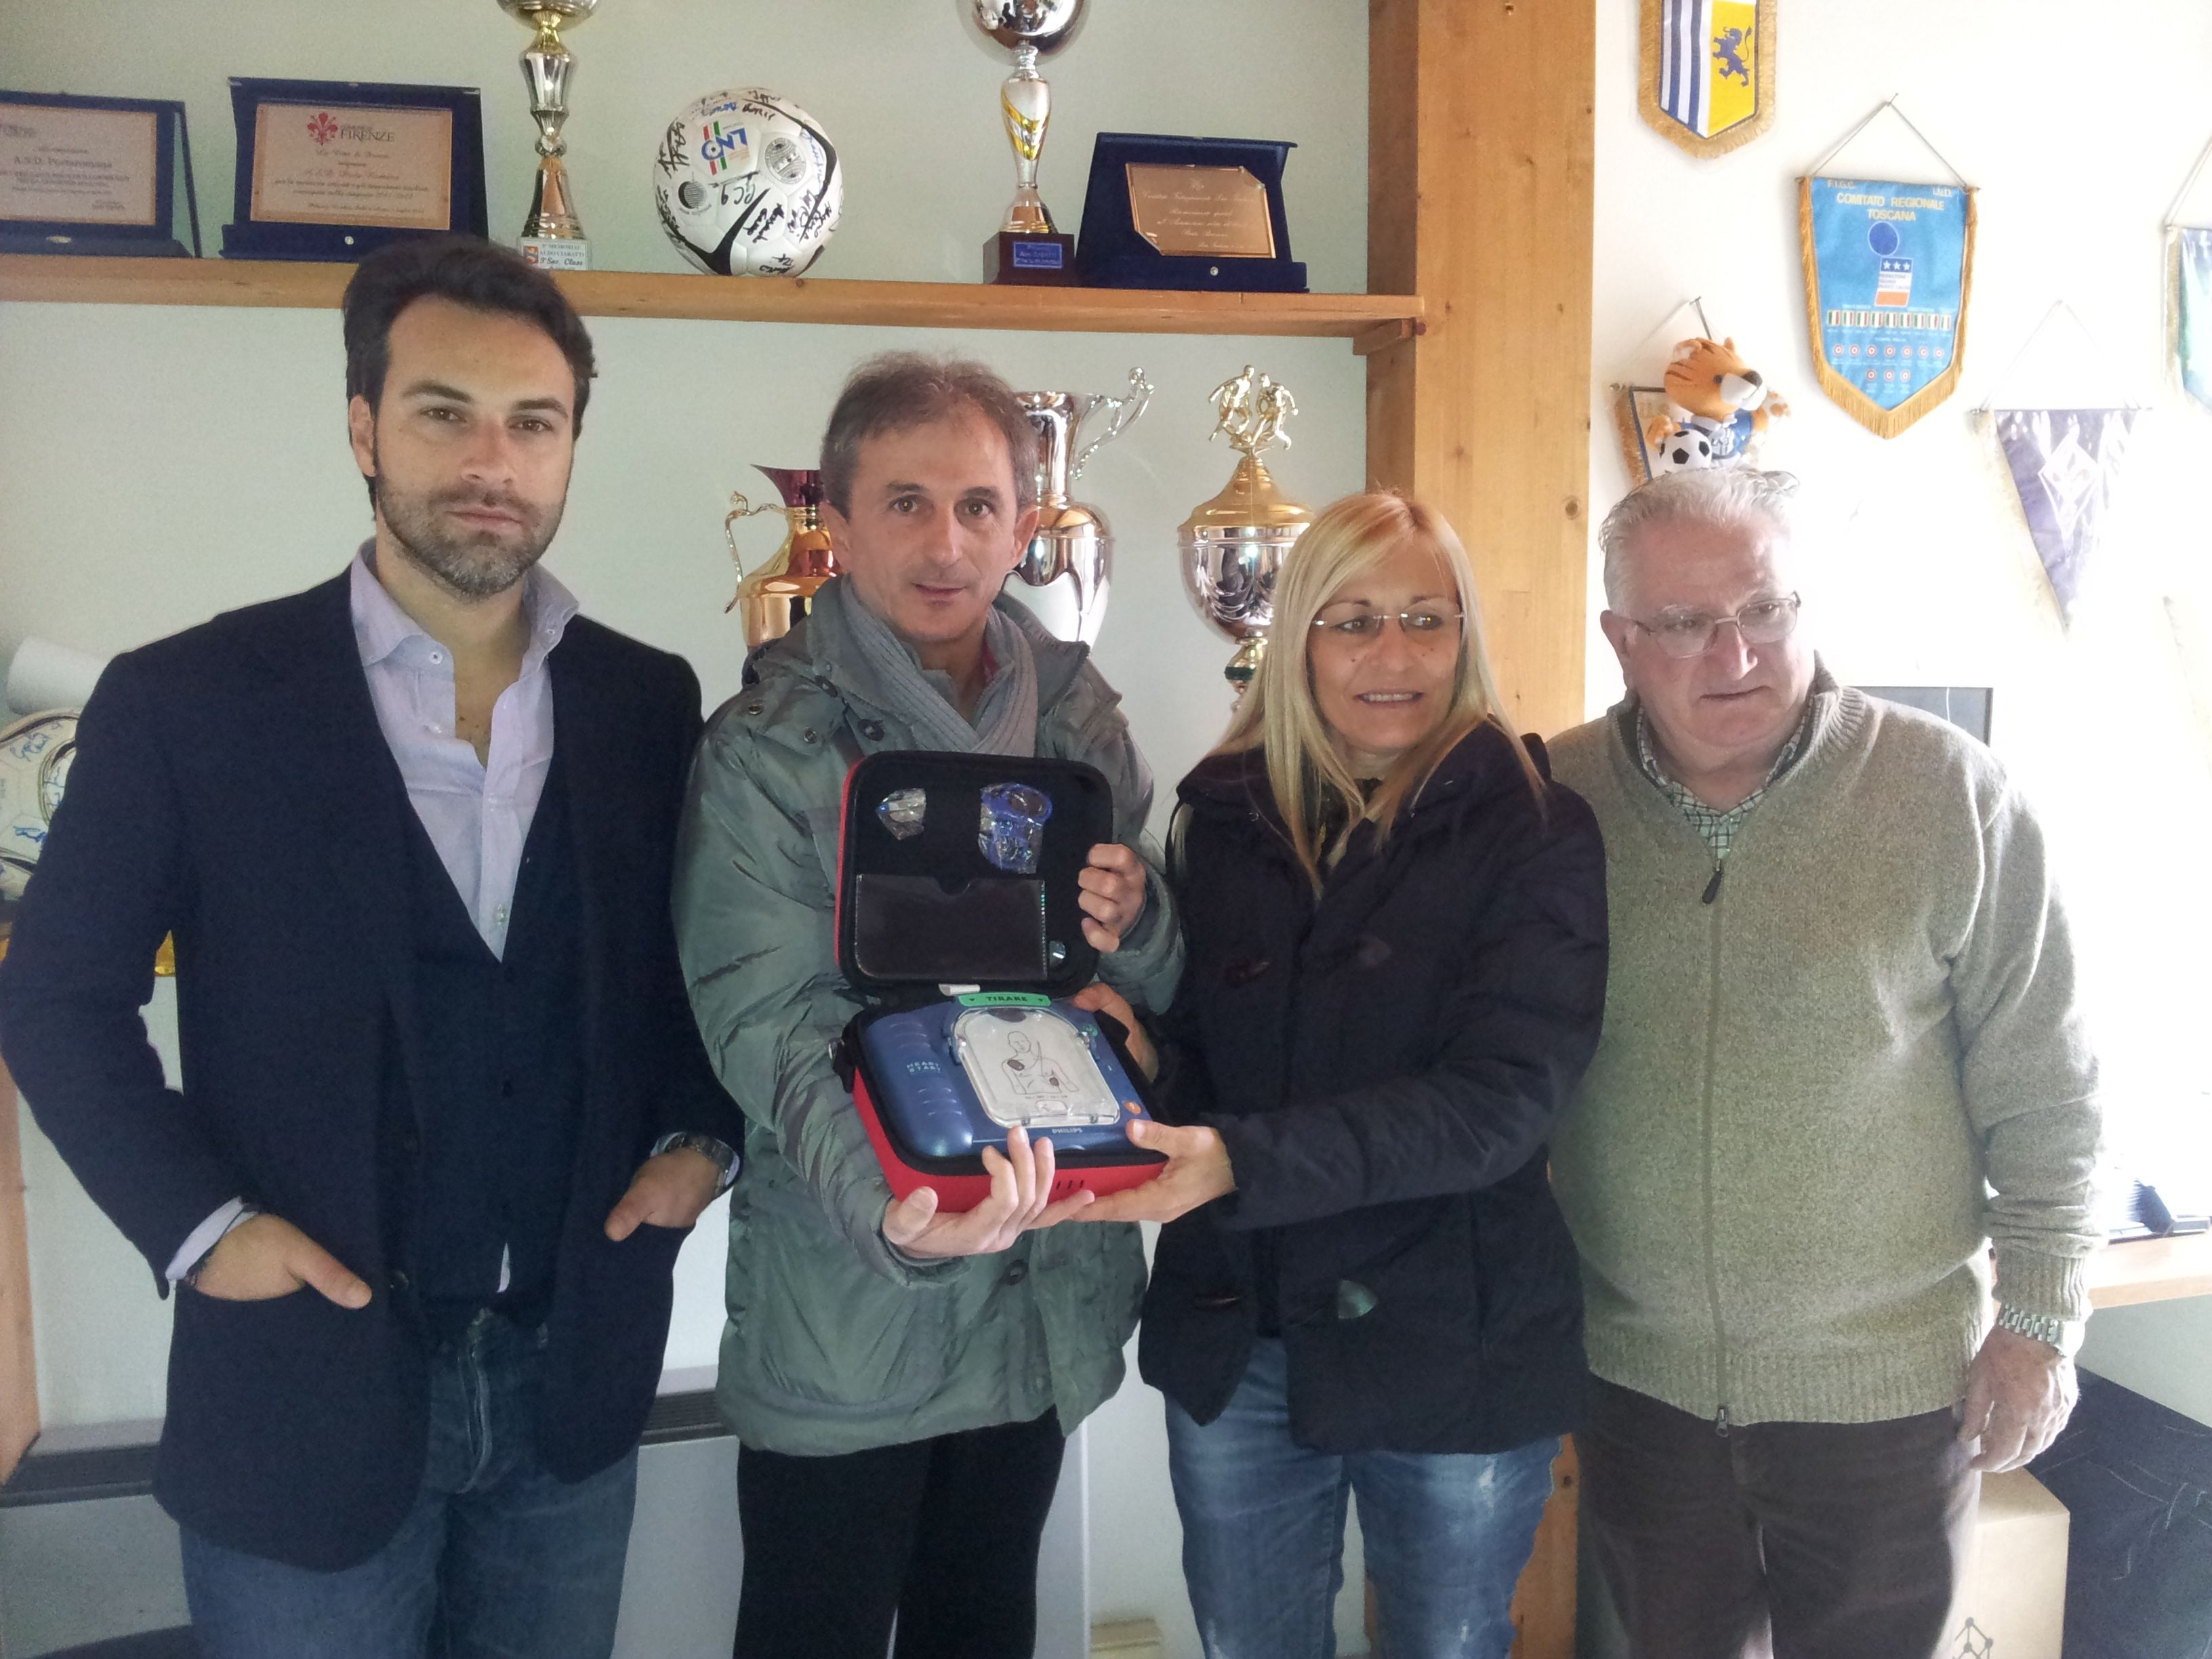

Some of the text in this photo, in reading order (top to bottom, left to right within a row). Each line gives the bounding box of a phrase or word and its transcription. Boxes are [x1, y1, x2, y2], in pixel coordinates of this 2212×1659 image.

[340, 129, 395, 142] FIRENZE
[1837, 192, 1944, 211] COMITATO REGIONALE
[1867, 209, 1917, 222] TOSCANA
